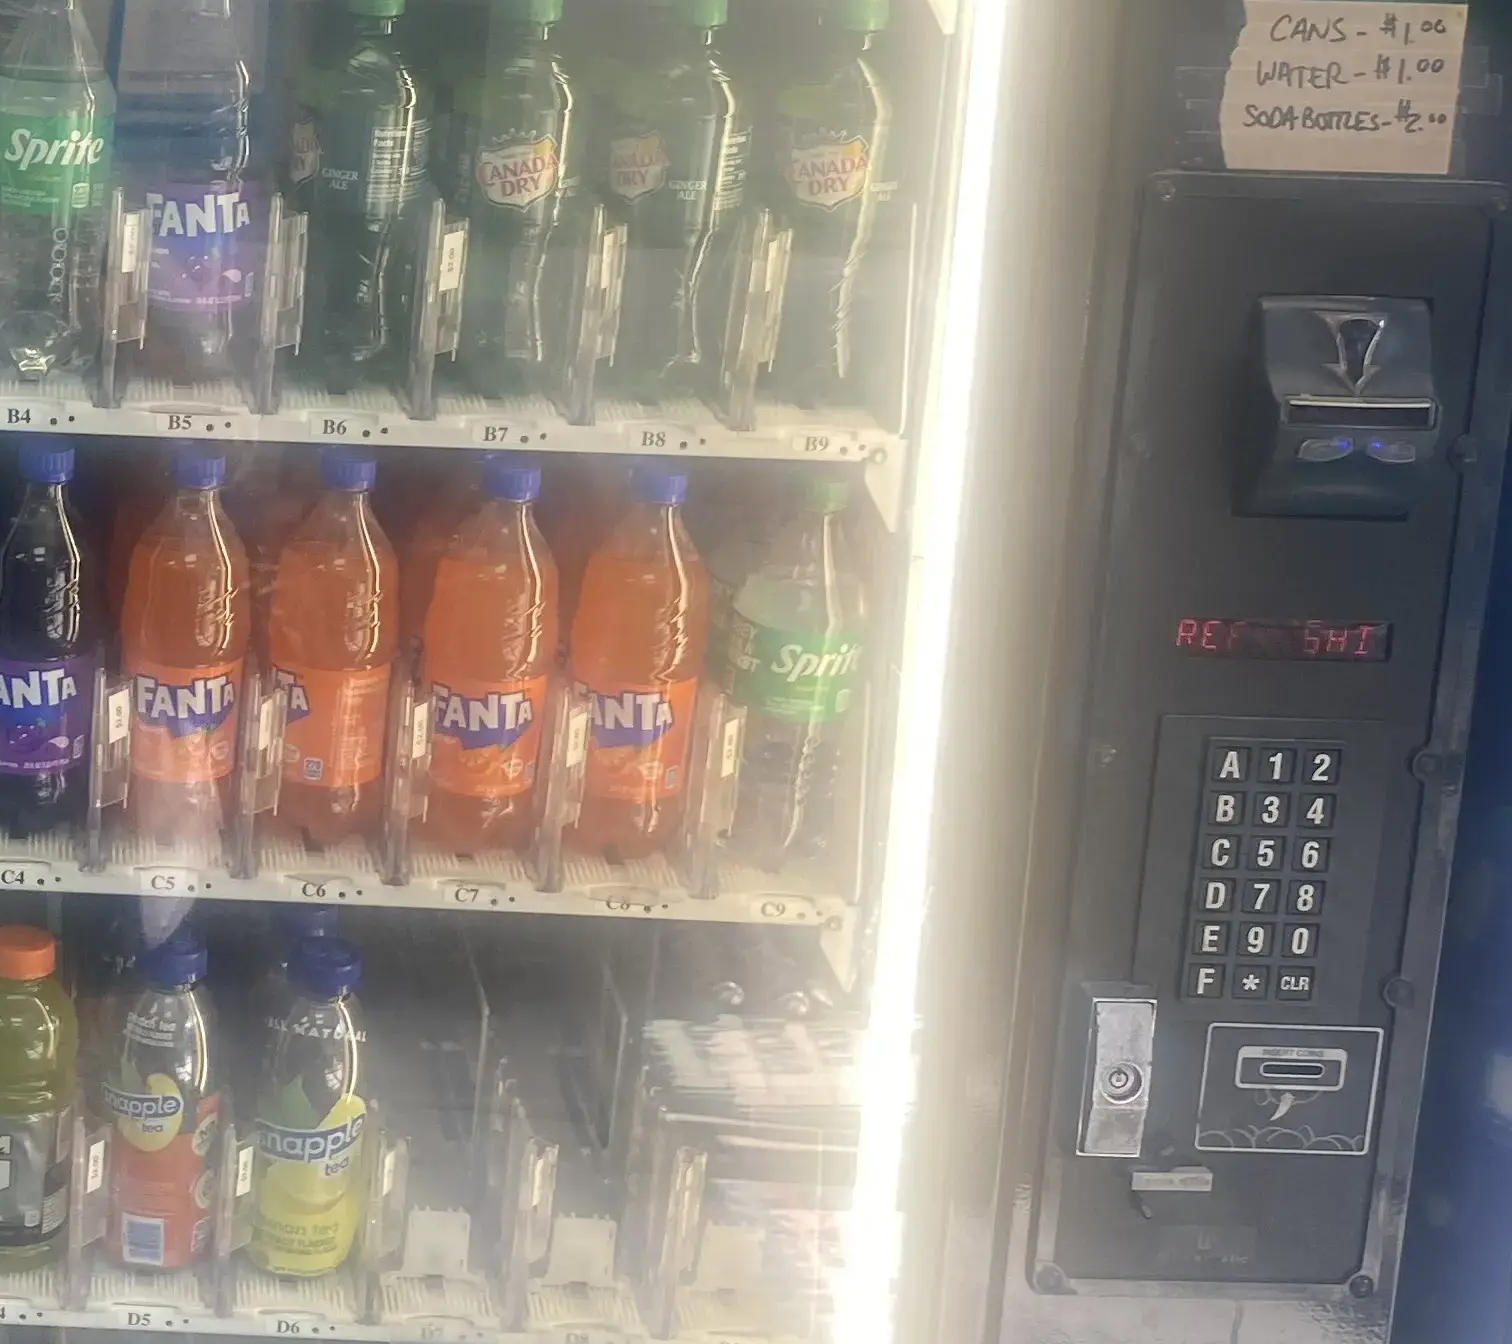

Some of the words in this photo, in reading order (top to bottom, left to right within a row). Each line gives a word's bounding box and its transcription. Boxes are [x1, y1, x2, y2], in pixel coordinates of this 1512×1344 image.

[1270, 14, 1346, 43] CANS
[1256, 59, 1349, 90] WATER
[5, 128, 104, 171] Sprite
[322, 167, 358, 180] GINGER
[477, 155, 559, 185] CANADA
[329, 179, 348, 191] ALE
[502, 175, 541, 197] DRY
[810, 177, 849, 196] DRY
[146, 192, 251, 238] FANTA
[7, 408, 31, 423] B4
[168, 415, 192, 430] B5
[323, 419, 346, 435] B6
[483, 426, 508, 442] B7
[641, 431, 666, 447] B8
[771, 642, 860, 683] Sprit
[137, 674, 234, 719] FANTA
[431, 685, 532, 730] FANTA
[1219, 751, 1239, 778] A
[1269, 752, 1283, 779] 1
[1311, 754, 1332, 782] 2
[1216, 795, 1235, 822] B
[1262, 796, 1279, 823] 3
[1306, 798, 1324, 824] 4
[1212, 838, 1230, 866] C
[1258, 840, 1274, 866] 5
[1302, 841, 1319, 868] 6
[1, 869, 25, 885] C4
[150, 876, 175, 890] C5
[302, 883, 326, 898] C6
[455, 888, 478, 904] C7
[1205, 882, 1225, 909] D
[1253, 883, 1270, 910] 7
[1296, 884, 1315, 911] 8
[1202, 925, 1220, 952] E
[1247, 926, 1265, 954] 9
[1292, 927, 1309, 955] 0
[1197, 968, 1216, 994] F
[1280, 976, 1309, 992] CLR
[142, 1123, 163, 1133] tea
[325, 1161, 348, 1176] tea
[128, 1313, 152, 1327] D5
[277, 1321, 300, 1335] D6
